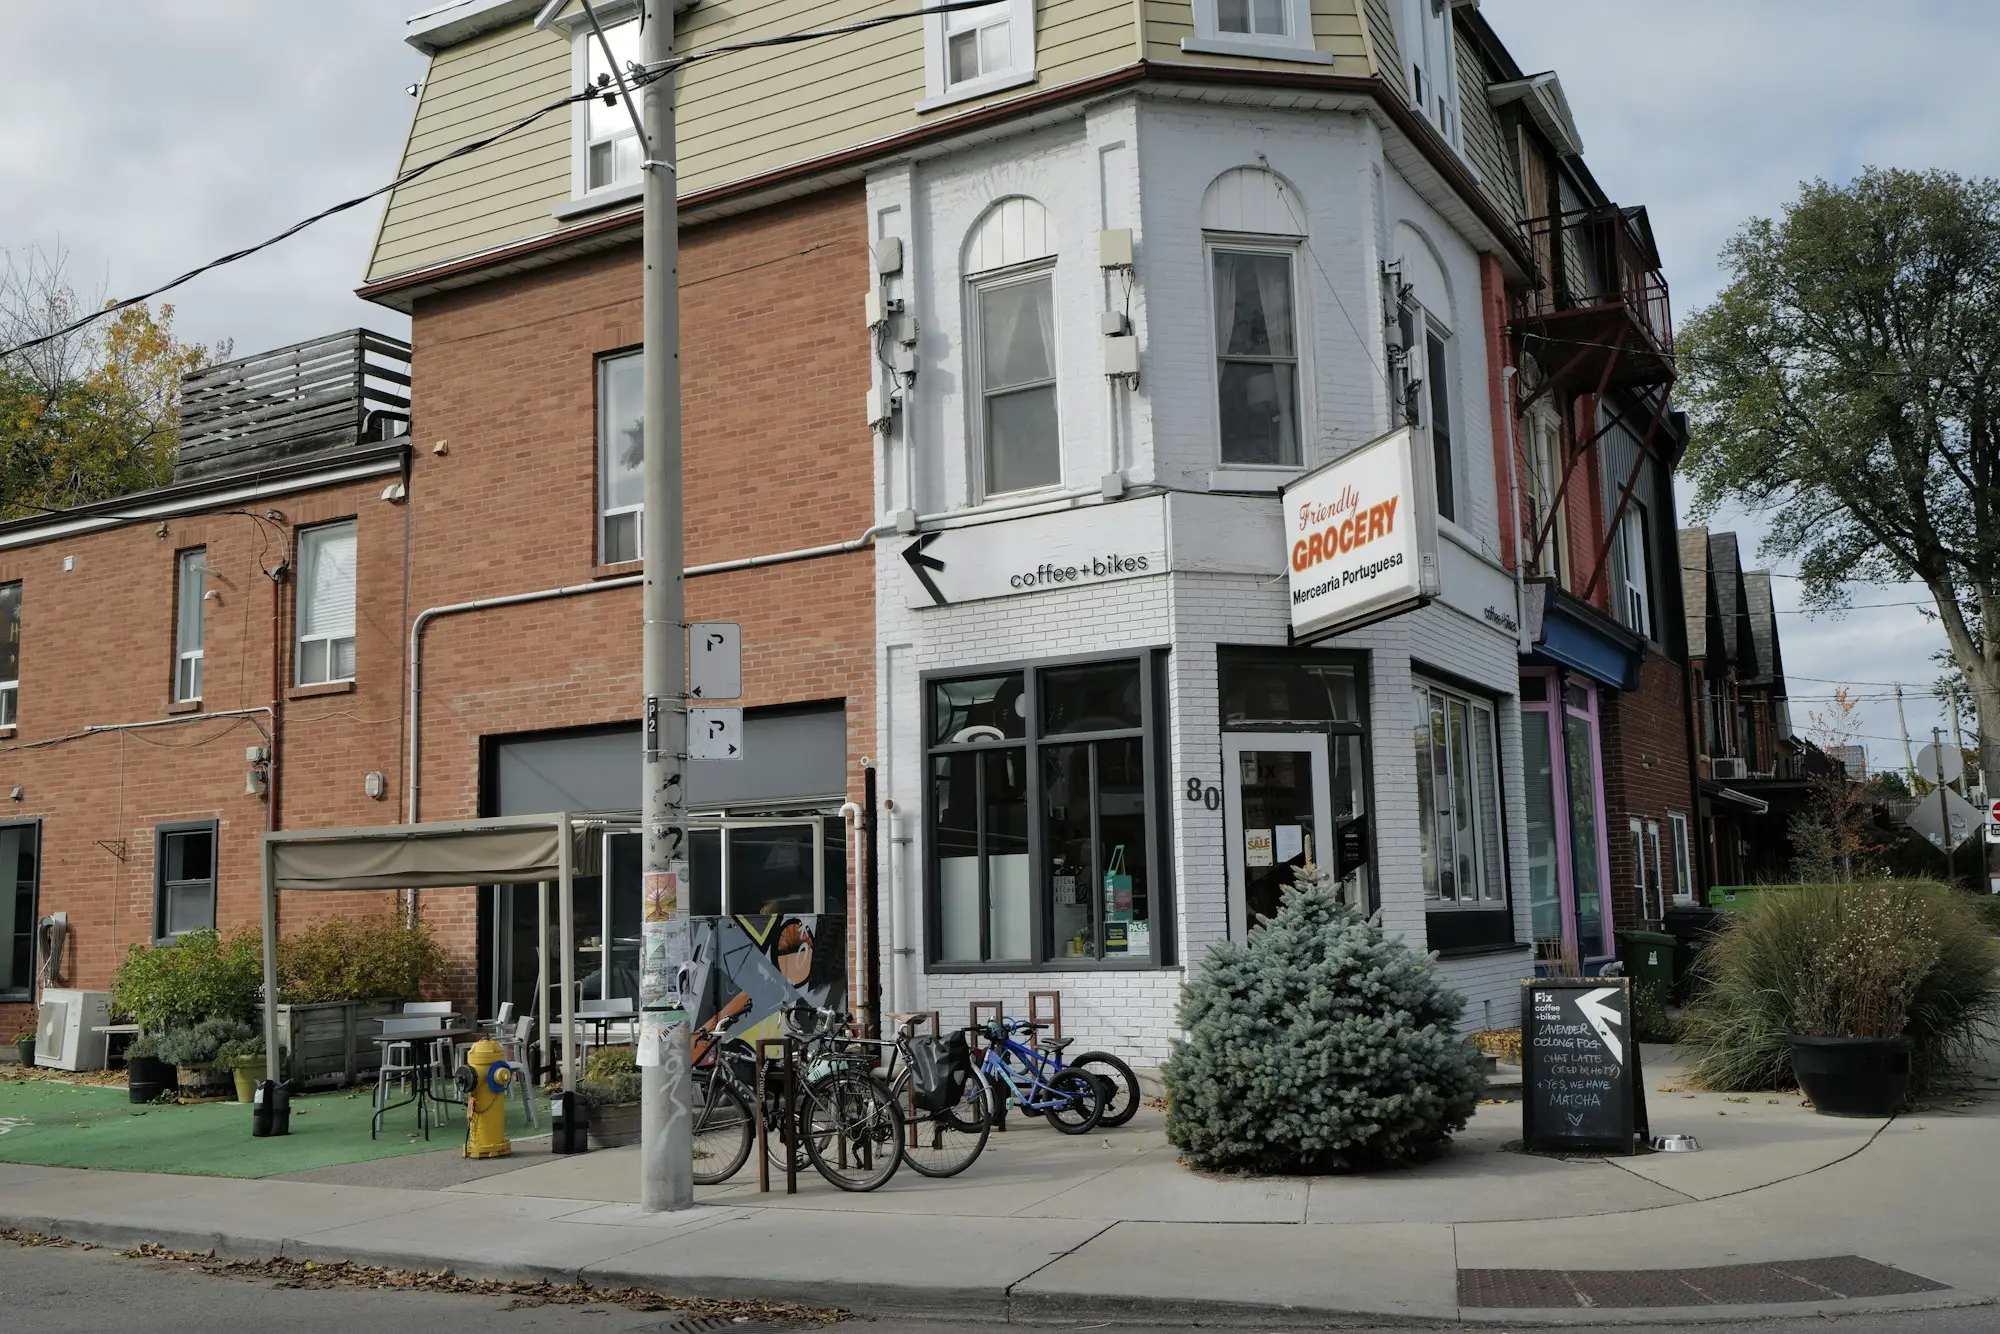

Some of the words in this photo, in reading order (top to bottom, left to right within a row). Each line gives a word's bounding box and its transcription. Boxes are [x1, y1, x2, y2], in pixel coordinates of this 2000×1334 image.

[1299, 484, 1359, 531] Friendly
[1292, 495, 1399, 573] GROCERY
[1010, 554, 1148, 588] coffee+bikes
[1293, 576, 1340, 605] Mercearia
[1343, 552, 1403, 587] Portuguesa
[1187, 777, 1220, 811] 80
[1247, 838, 1270, 850] SALE
[1129, 924, 1148, 932] PASS
[1534, 992, 1553, 1003] Fix
[1534, 1004, 1561, 1012] coffee
[1535, 1013, 1561, 1021] +bikes
[1539, 1023, 1591, 1035] LAVENDER
[1533, 1037, 1574, 1048] OOLONG
[1543, 1053, 1569, 1063] CHAI
[1571, 1054, 1602, 1063] LATTE
[1570, 1081, 1584, 1089] WE
[1586, 1080, 1611, 1090] HAVE
[1549, 1093, 1601, 1106] MATCHA
